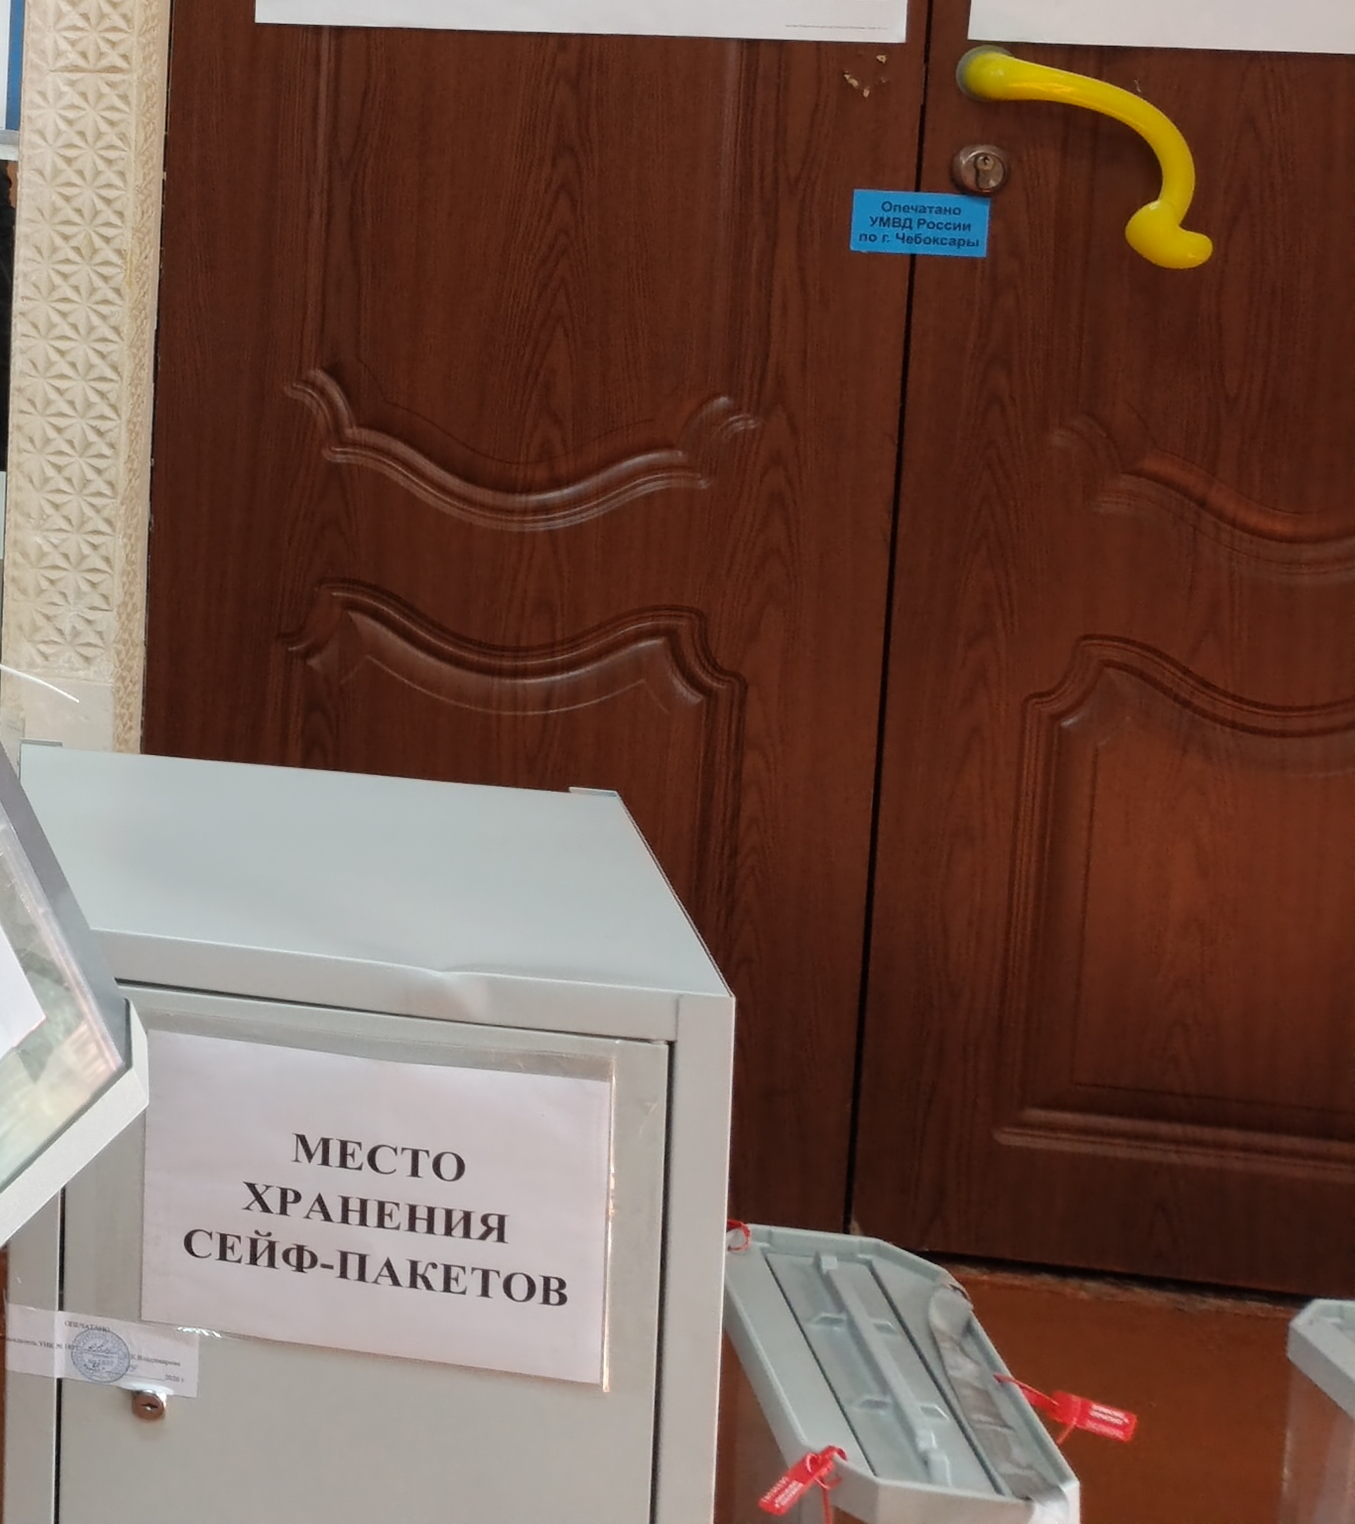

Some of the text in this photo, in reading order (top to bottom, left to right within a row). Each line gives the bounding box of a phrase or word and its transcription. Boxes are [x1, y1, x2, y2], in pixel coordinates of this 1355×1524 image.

[869, 216, 972, 232] УМВД России
[881, 201, 962, 216] Опечатано
[858, 232, 980, 249] по г. Чебоксары
[292, 1132, 467, 1184] МЕСТО
[242, 1180, 510, 1245] ХРАНЕНИЯ
[182, 1226, 569, 1308] СЕЙФ-ПАКЕТОВ
